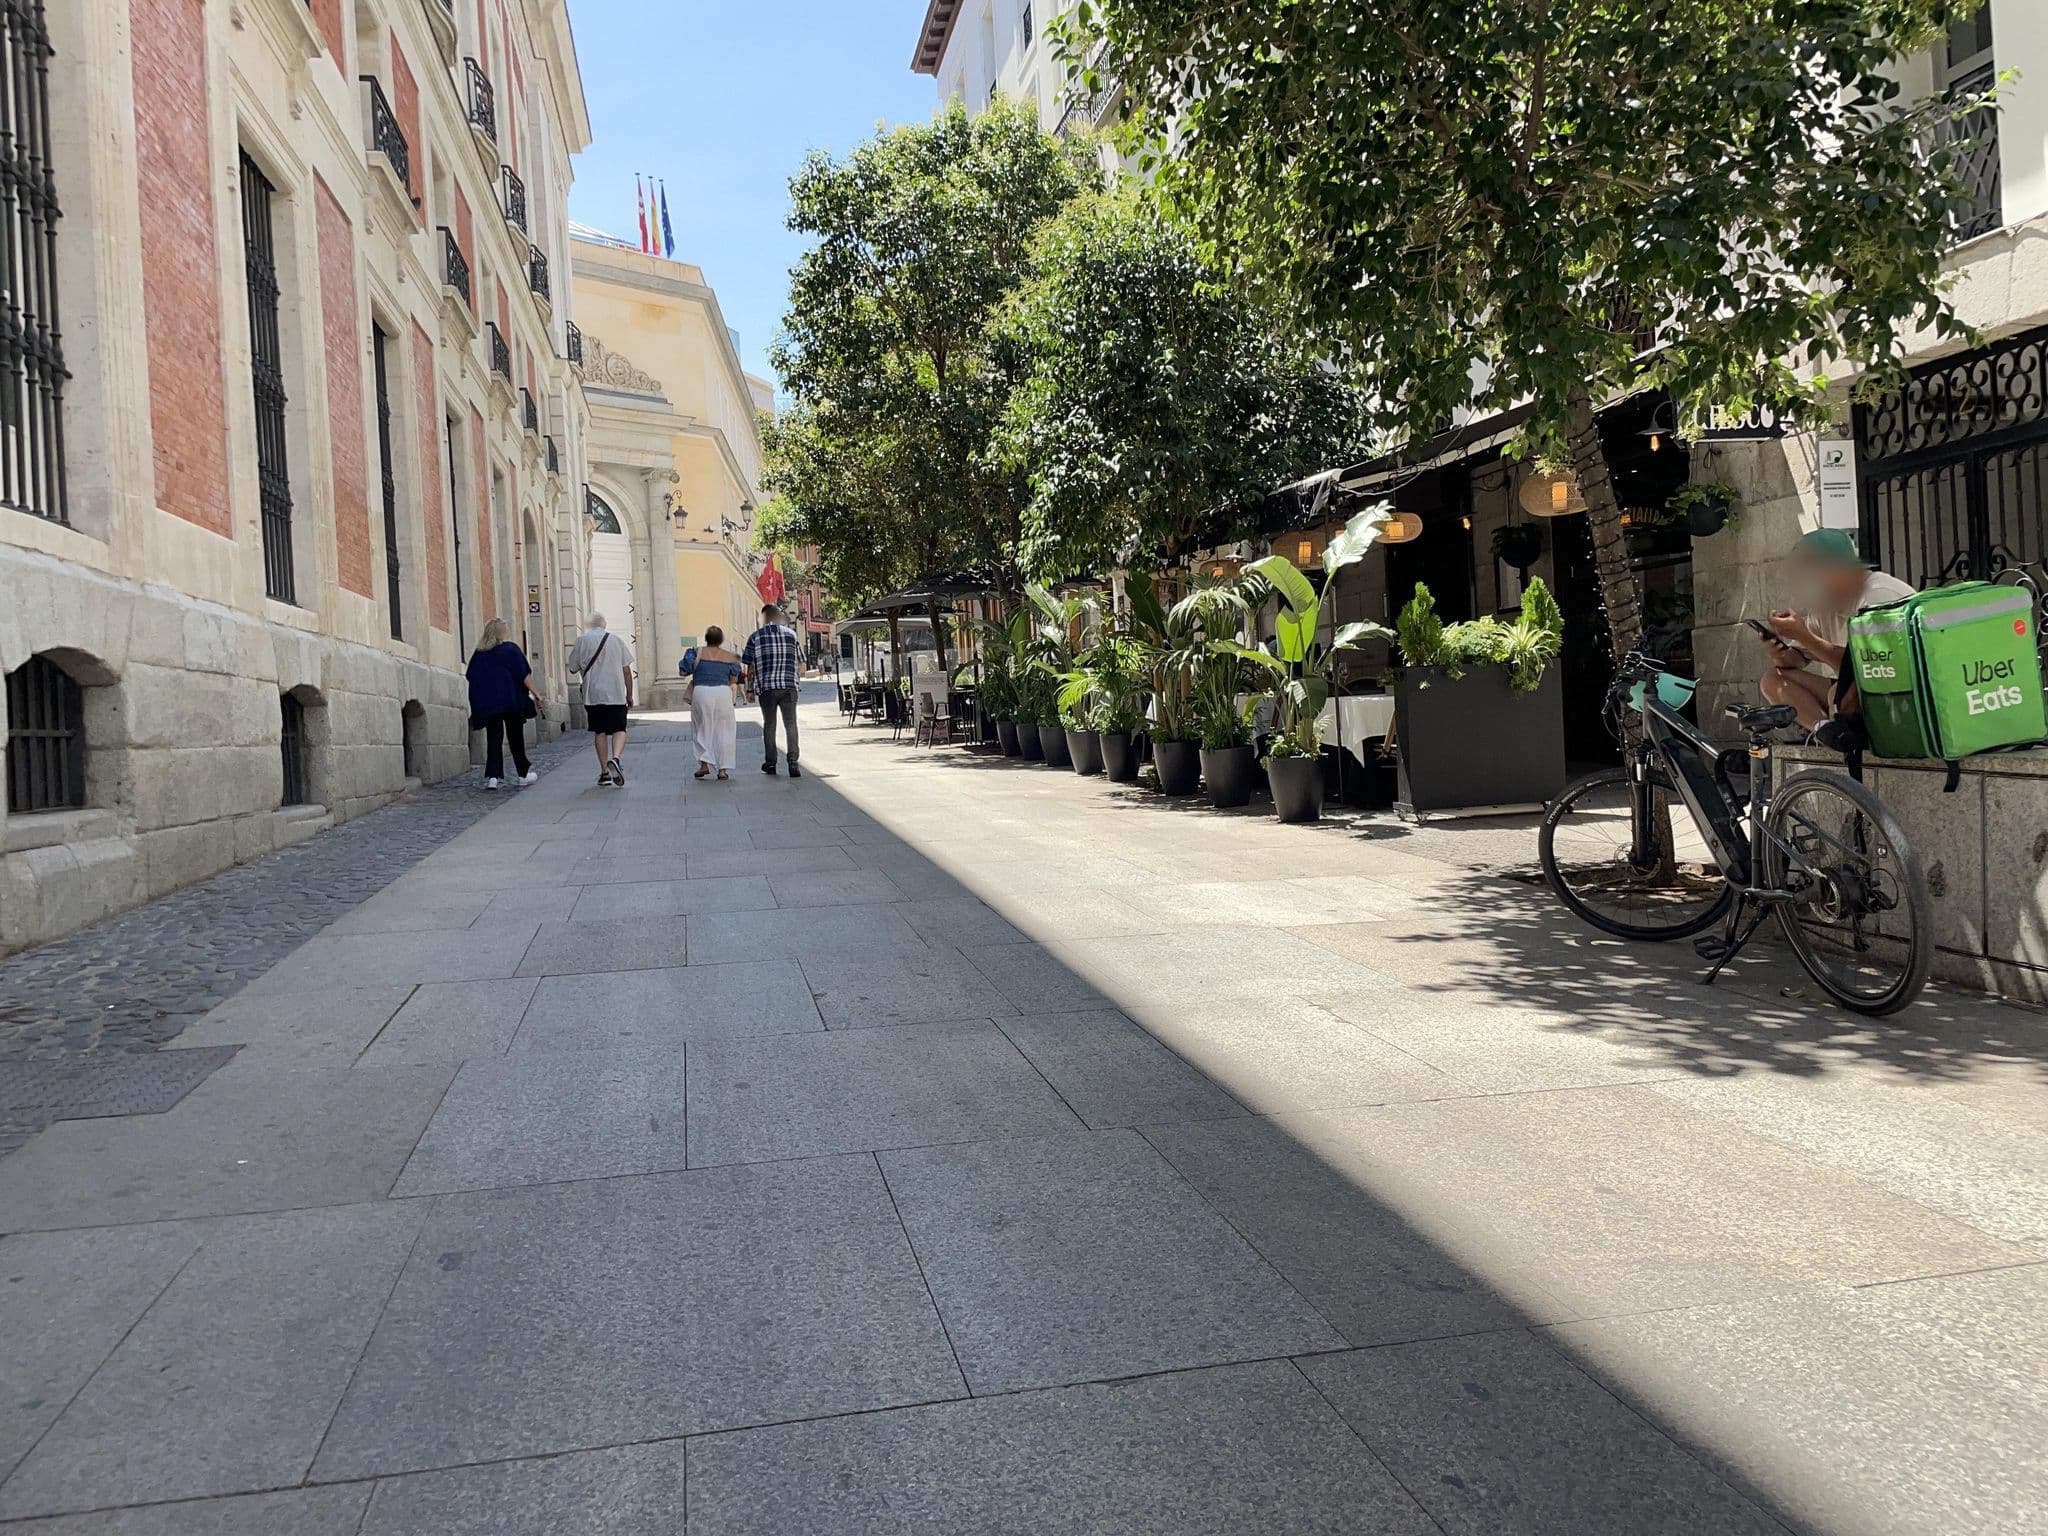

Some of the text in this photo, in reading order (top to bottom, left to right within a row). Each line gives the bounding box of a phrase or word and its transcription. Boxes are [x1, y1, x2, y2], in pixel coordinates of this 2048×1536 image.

[1859, 648, 1893, 662] Uber
[1862, 664, 1896, 679] Eats
[1962, 658, 2015, 686] Uber
[1966, 684, 2023, 716] Eats
